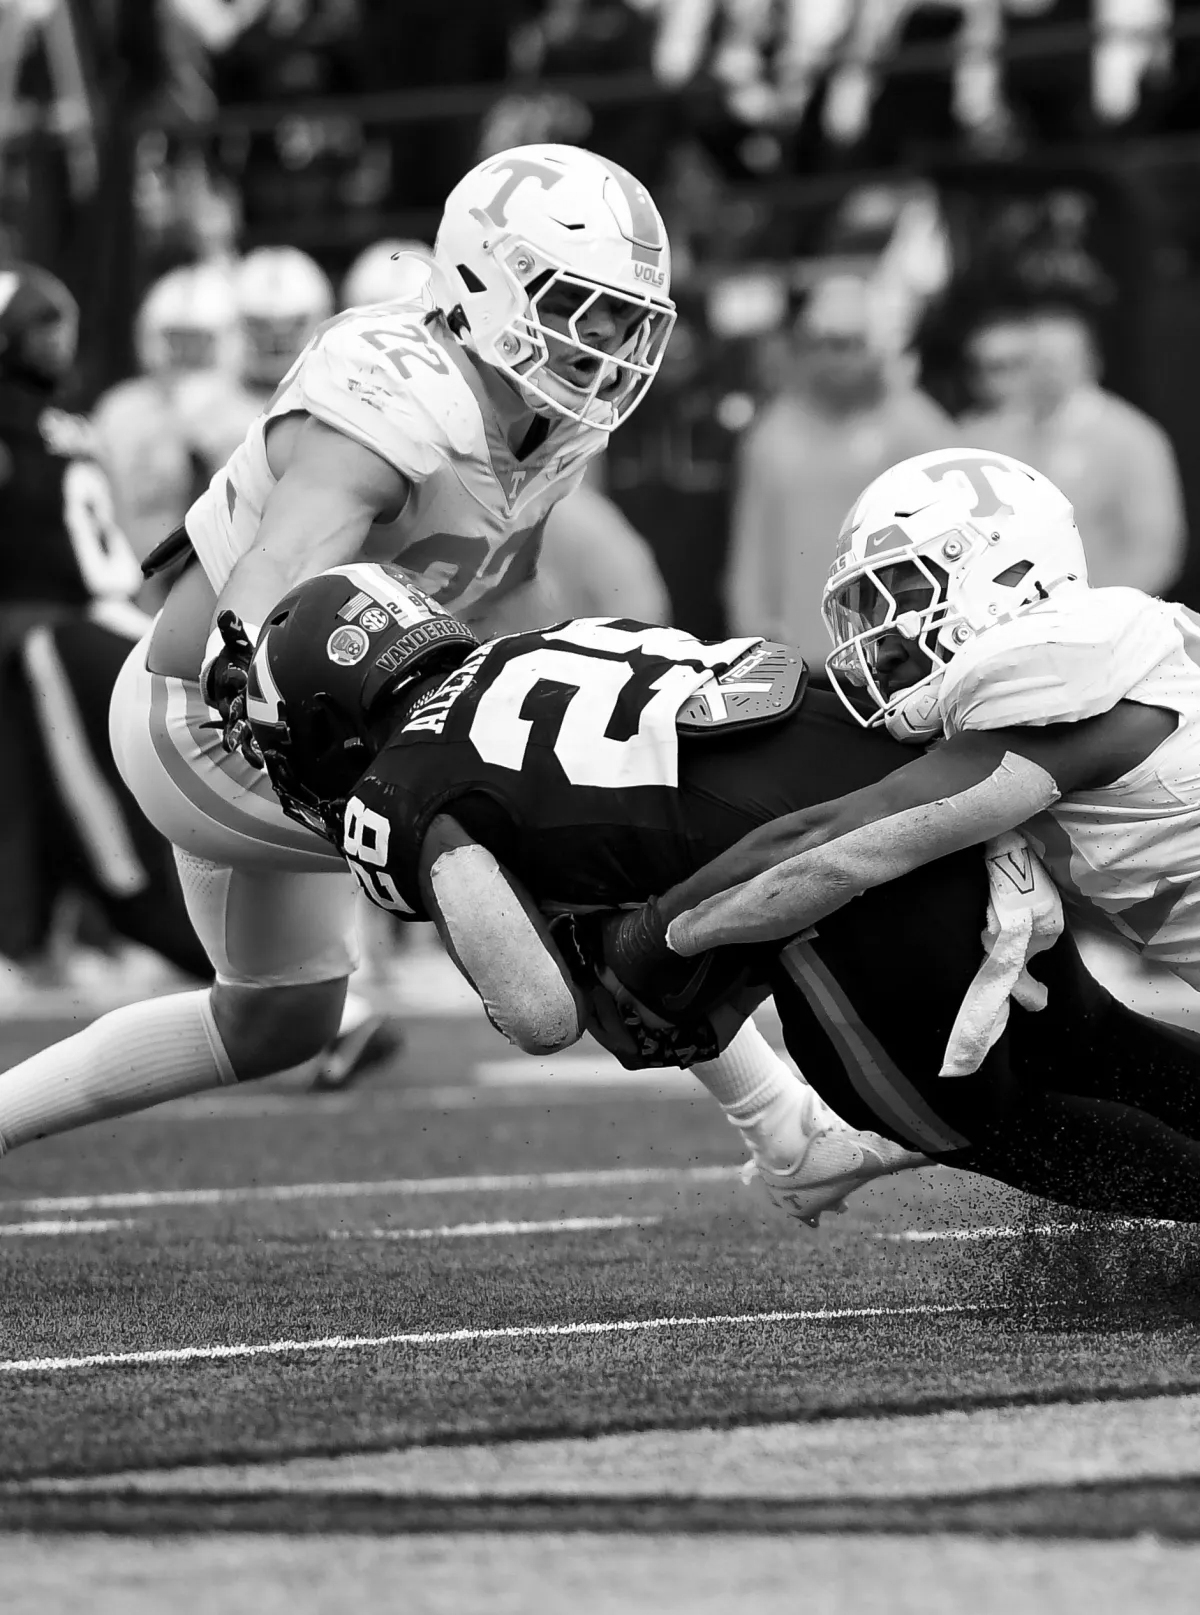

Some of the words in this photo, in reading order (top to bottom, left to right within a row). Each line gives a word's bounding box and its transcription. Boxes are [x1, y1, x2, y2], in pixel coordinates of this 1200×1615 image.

[468, 158, 565, 228] T
[633, 263, 666, 287] VOLS
[357, 323, 450, 380] 22
[509, 470, 527, 499] T
[920, 457, 1016, 518] T
[361, 608, 388, 632] SEC
[987, 847, 1035, 895] V
